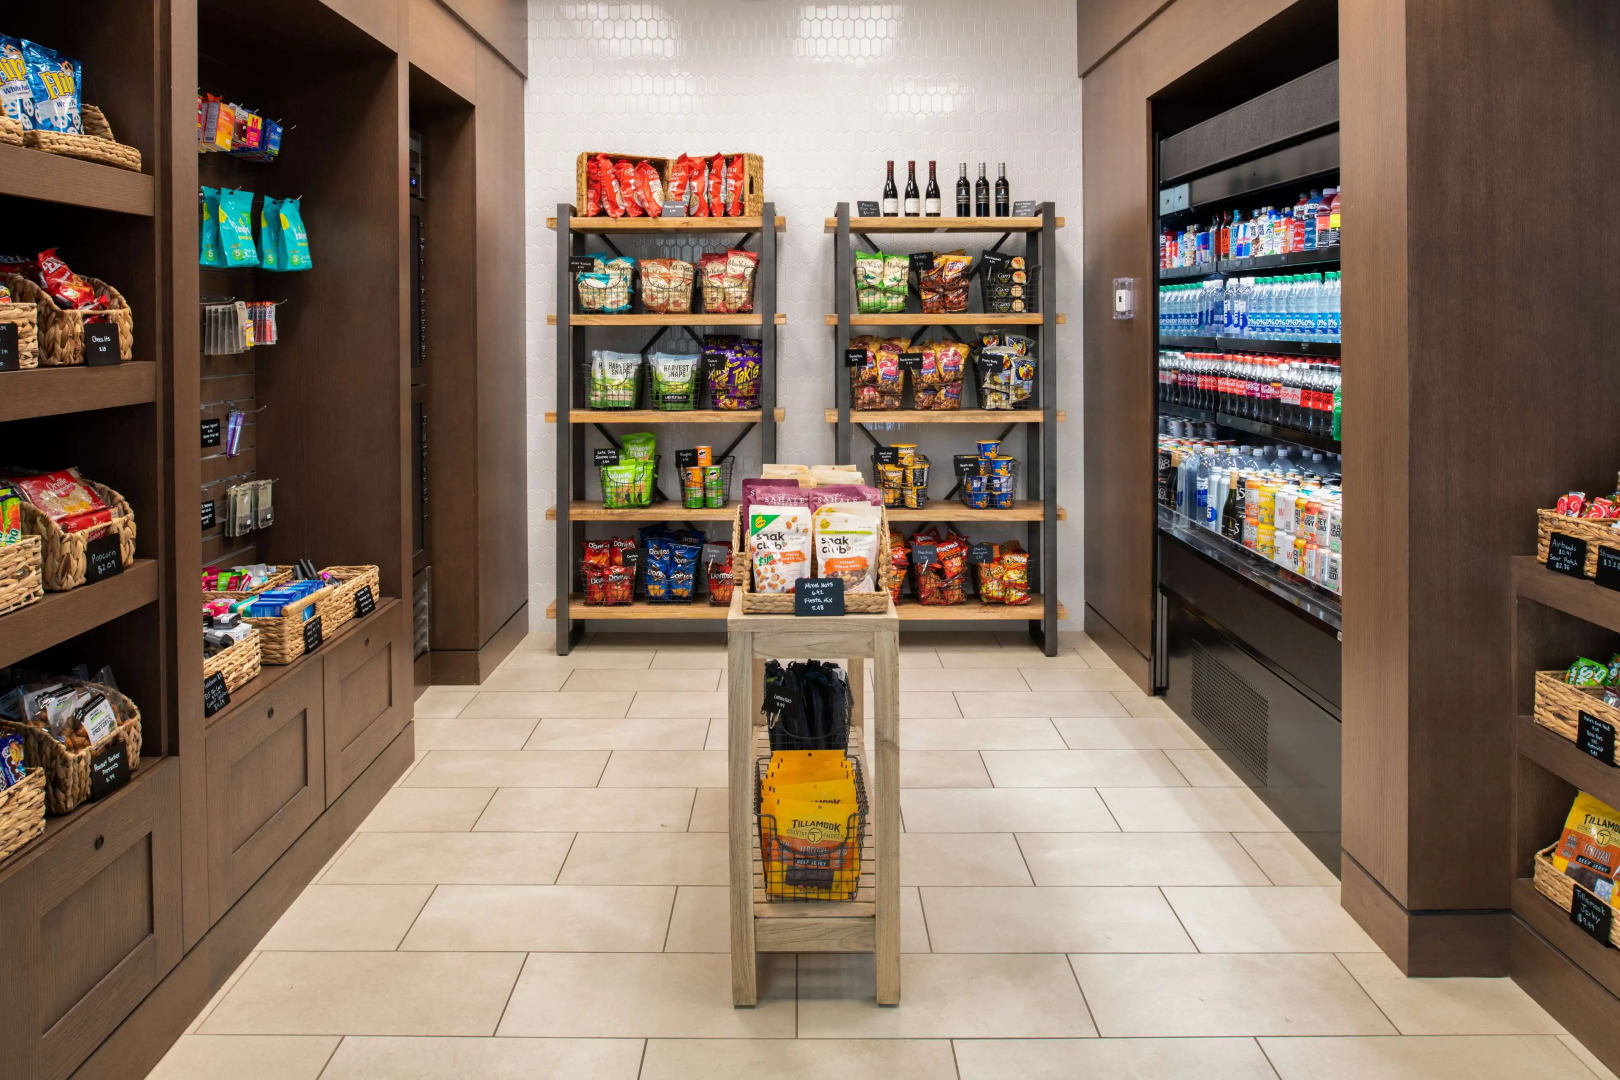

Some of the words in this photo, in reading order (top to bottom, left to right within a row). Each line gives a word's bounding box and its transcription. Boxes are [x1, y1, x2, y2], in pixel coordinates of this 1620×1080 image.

[40, 71, 76, 100] Flip
[663, 364, 690, 372] HARVEST
[667, 370, 687, 378] SNAPS
[733, 364, 760, 386] Takis
[648, 549, 670, 557] Doritos
[1551, 539, 1577, 552] Airheads
[92, 550, 117, 564] Popcorn
[97, 560, 117, 576] $2.09
[791, 818, 842, 833] TILLAMOOK
[1583, 843, 1611, 864] TERIYAKI
[1578, 857, 1591, 867] BEEF
[1591, 862, 1608, 873] JERKY
[1574, 888, 1606, 916] Tillamook
[1579, 903, 1600, 923] Jerky
